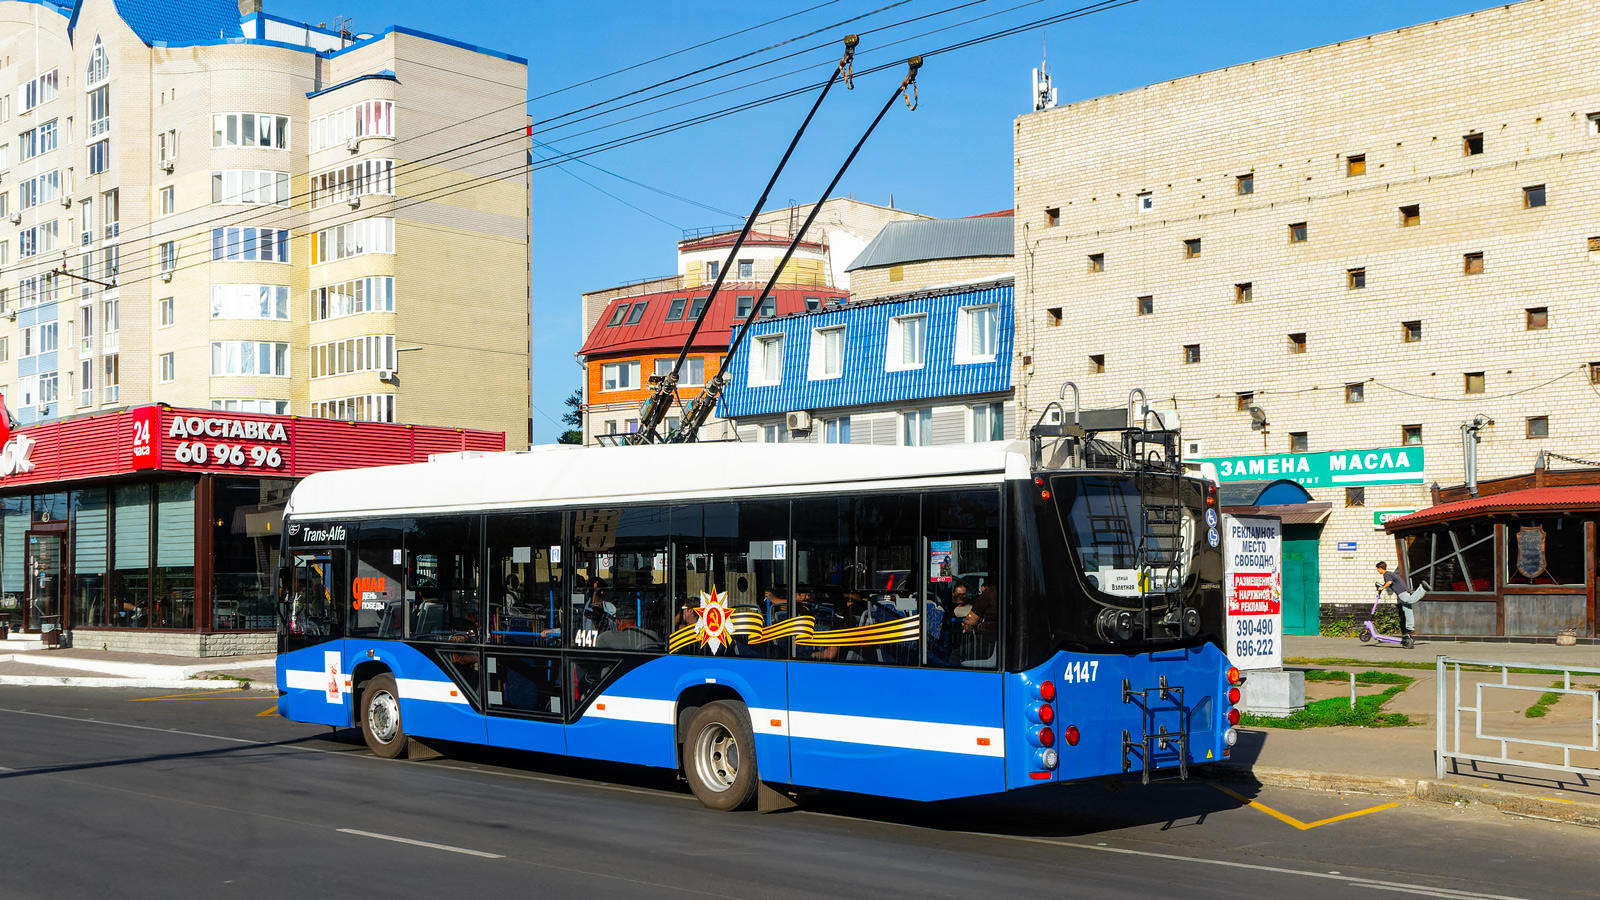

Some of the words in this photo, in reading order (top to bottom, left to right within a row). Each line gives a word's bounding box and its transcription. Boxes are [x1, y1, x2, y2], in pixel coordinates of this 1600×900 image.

[133, 419, 150, 446] 24
[170, 416, 287, 441] ДОСТАВКА
[133, 445, 150, 456] часа
[175, 442, 208, 464] 60
[213, 443, 245, 466] 96
[250, 445, 282, 468] 96
[1220, 457, 1311, 477] ЗАМЕНА
[1329, 451, 1411, 472] МАСЛА
[303, 525, 346, 542] Trans-Alfa
[1232, 526, 1276, 540] РЕКЛАМНОЕ
[1241, 540, 1267, 553] МЕСТО
[1234, 554, 1274, 569] СВОБОДНО
[352, 576, 362, 610] 9
[361, 576, 386, 592] МАЯ
[362, 592, 377, 600] ДЕНЬ
[361, 601, 385, 610] ПОБЕДЫ
[1236, 618, 1273, 637] 390-490
[574, 629, 598, 647] 4147
[1236, 638, 1273, 657] 696-222
[1064, 660, 1099, 684] 4147
